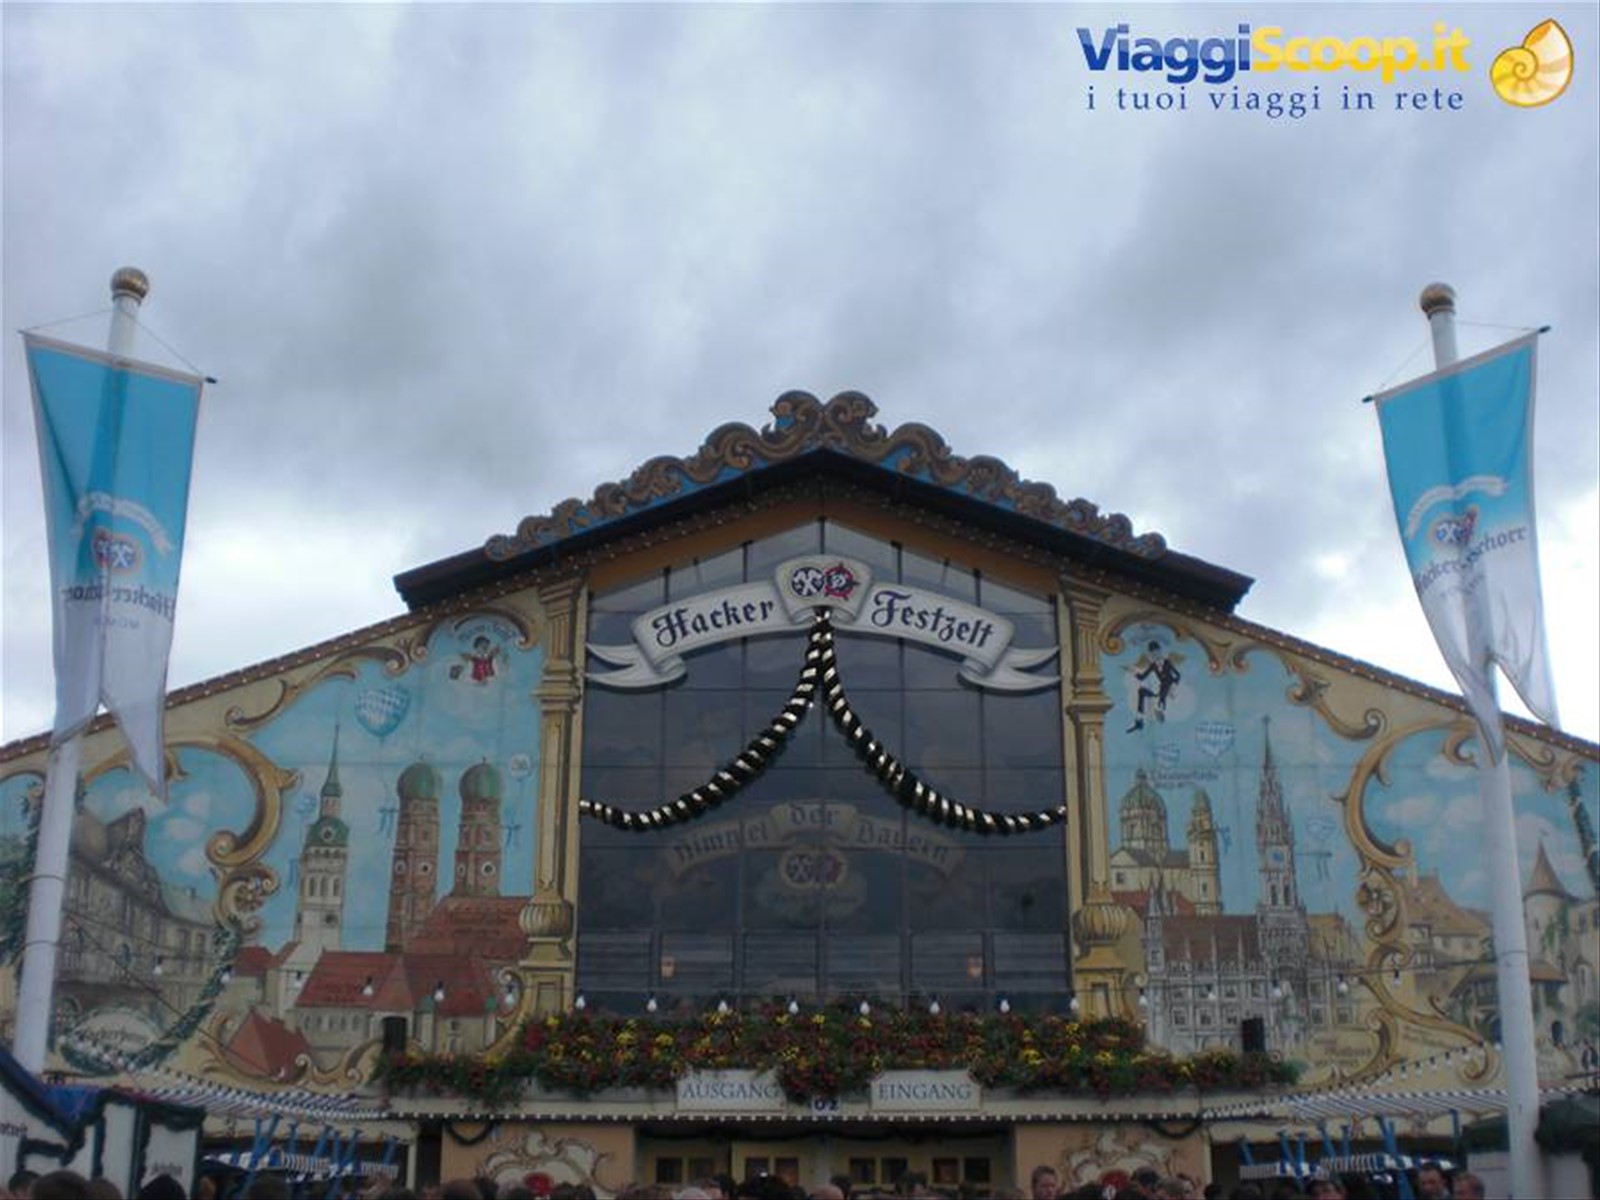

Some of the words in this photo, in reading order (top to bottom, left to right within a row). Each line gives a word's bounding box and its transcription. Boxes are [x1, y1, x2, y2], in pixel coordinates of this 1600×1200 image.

[651, 599, 775, 648] Hacker
[870, 589, 995, 649] Festzelt
[682, 1079, 779, 1100] AUSGANG
[878, 1079, 972, 1100] EINGANG
